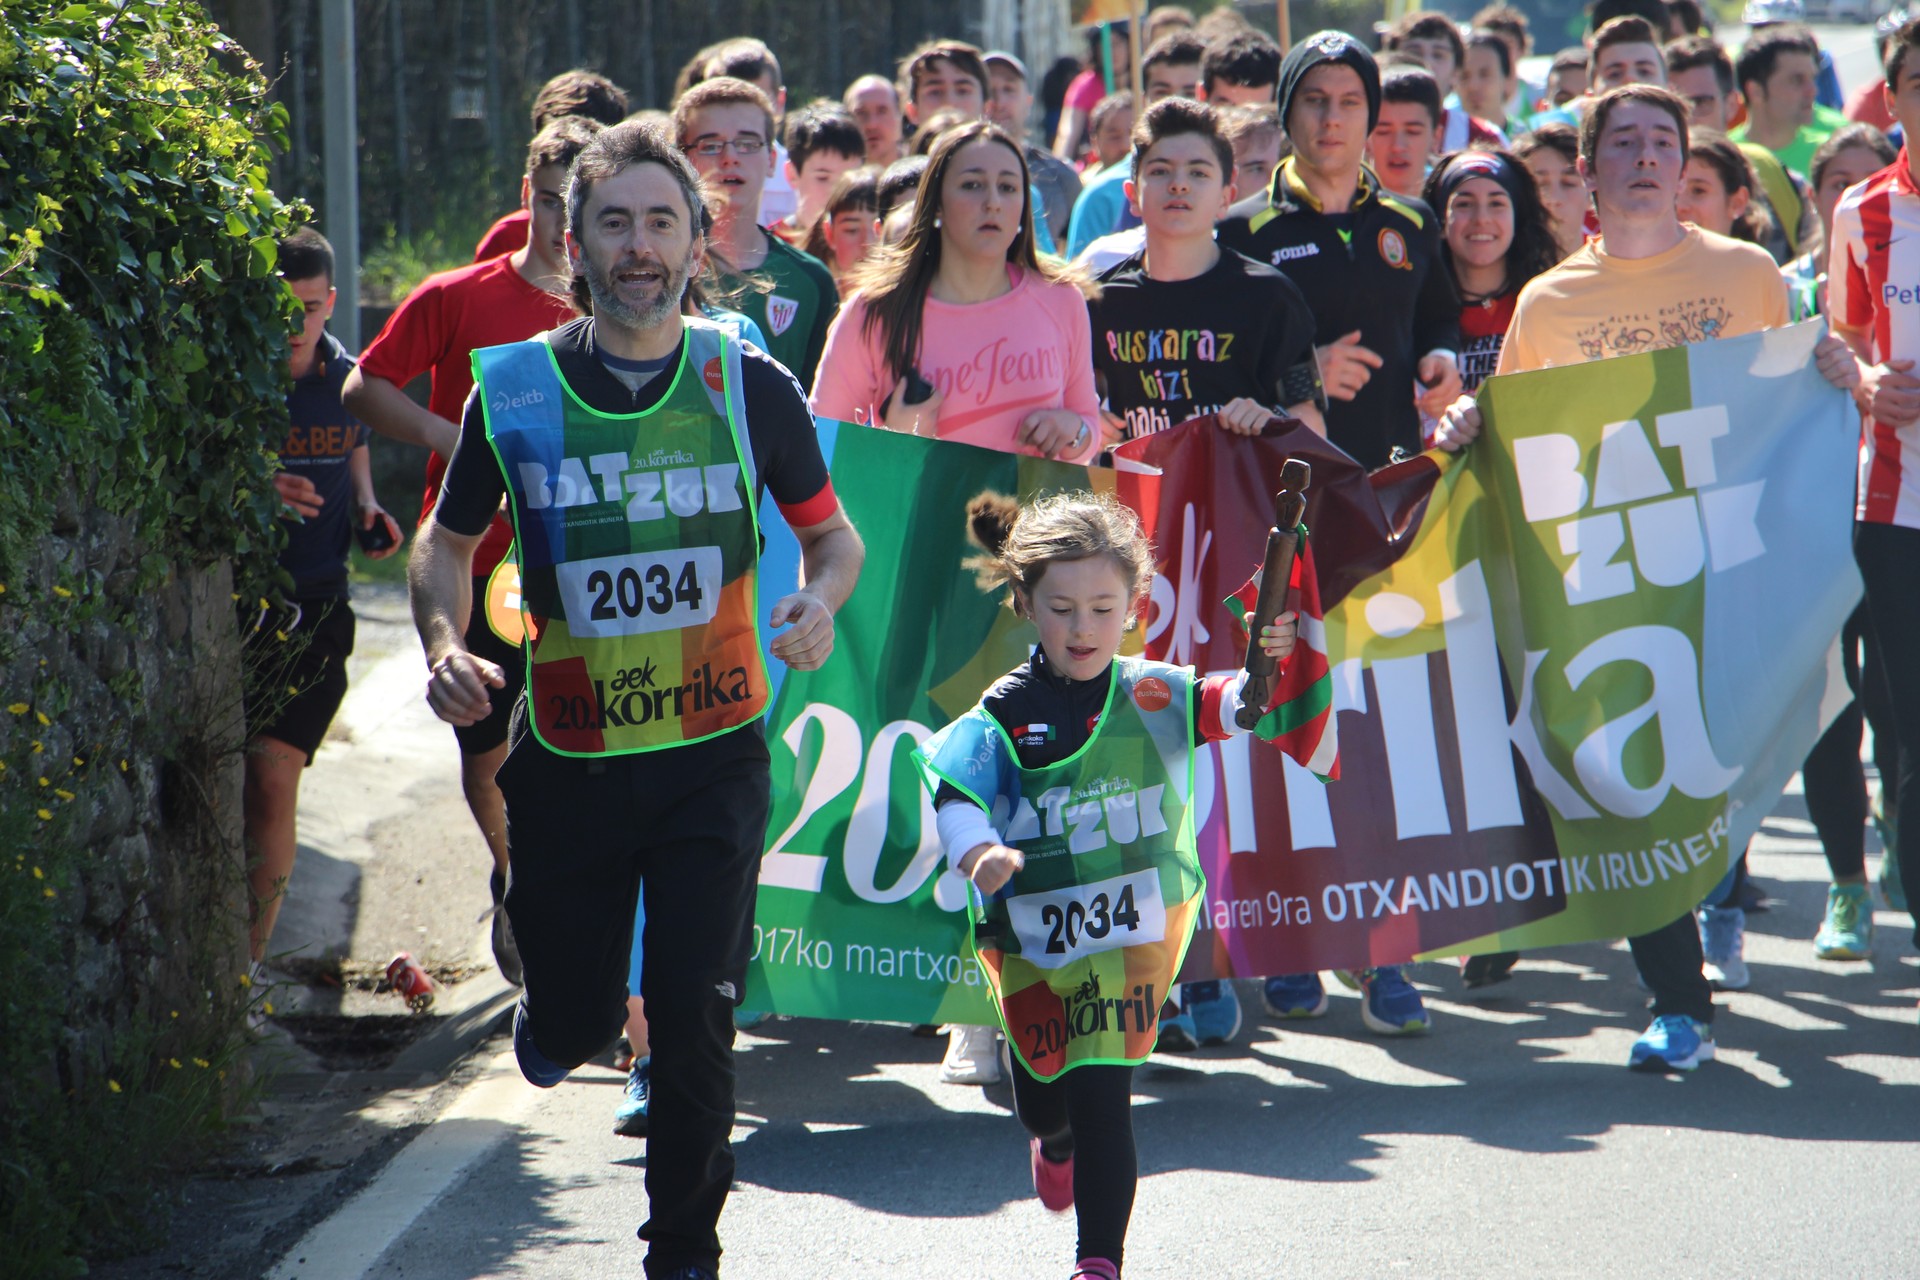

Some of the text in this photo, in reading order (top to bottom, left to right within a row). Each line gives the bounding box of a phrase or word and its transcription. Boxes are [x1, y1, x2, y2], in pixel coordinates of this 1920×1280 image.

[1106, 328, 1234, 363] euskaraz
[511, 388, 545, 408] eitb
[1139, 369, 1193, 400] bizi
[1513, 404, 1730, 522] BAT
[1557, 478, 1767, 606] ZUK
[587, 561, 702, 621] 2034
[594, 662, 753, 729] korrika
[611, 656, 657, 691] aek
[1042, 883, 1140, 954] 2034
[1266, 890, 1312, 927] 9ra
[1322, 855, 1596, 923] OTXANDIOTIK
